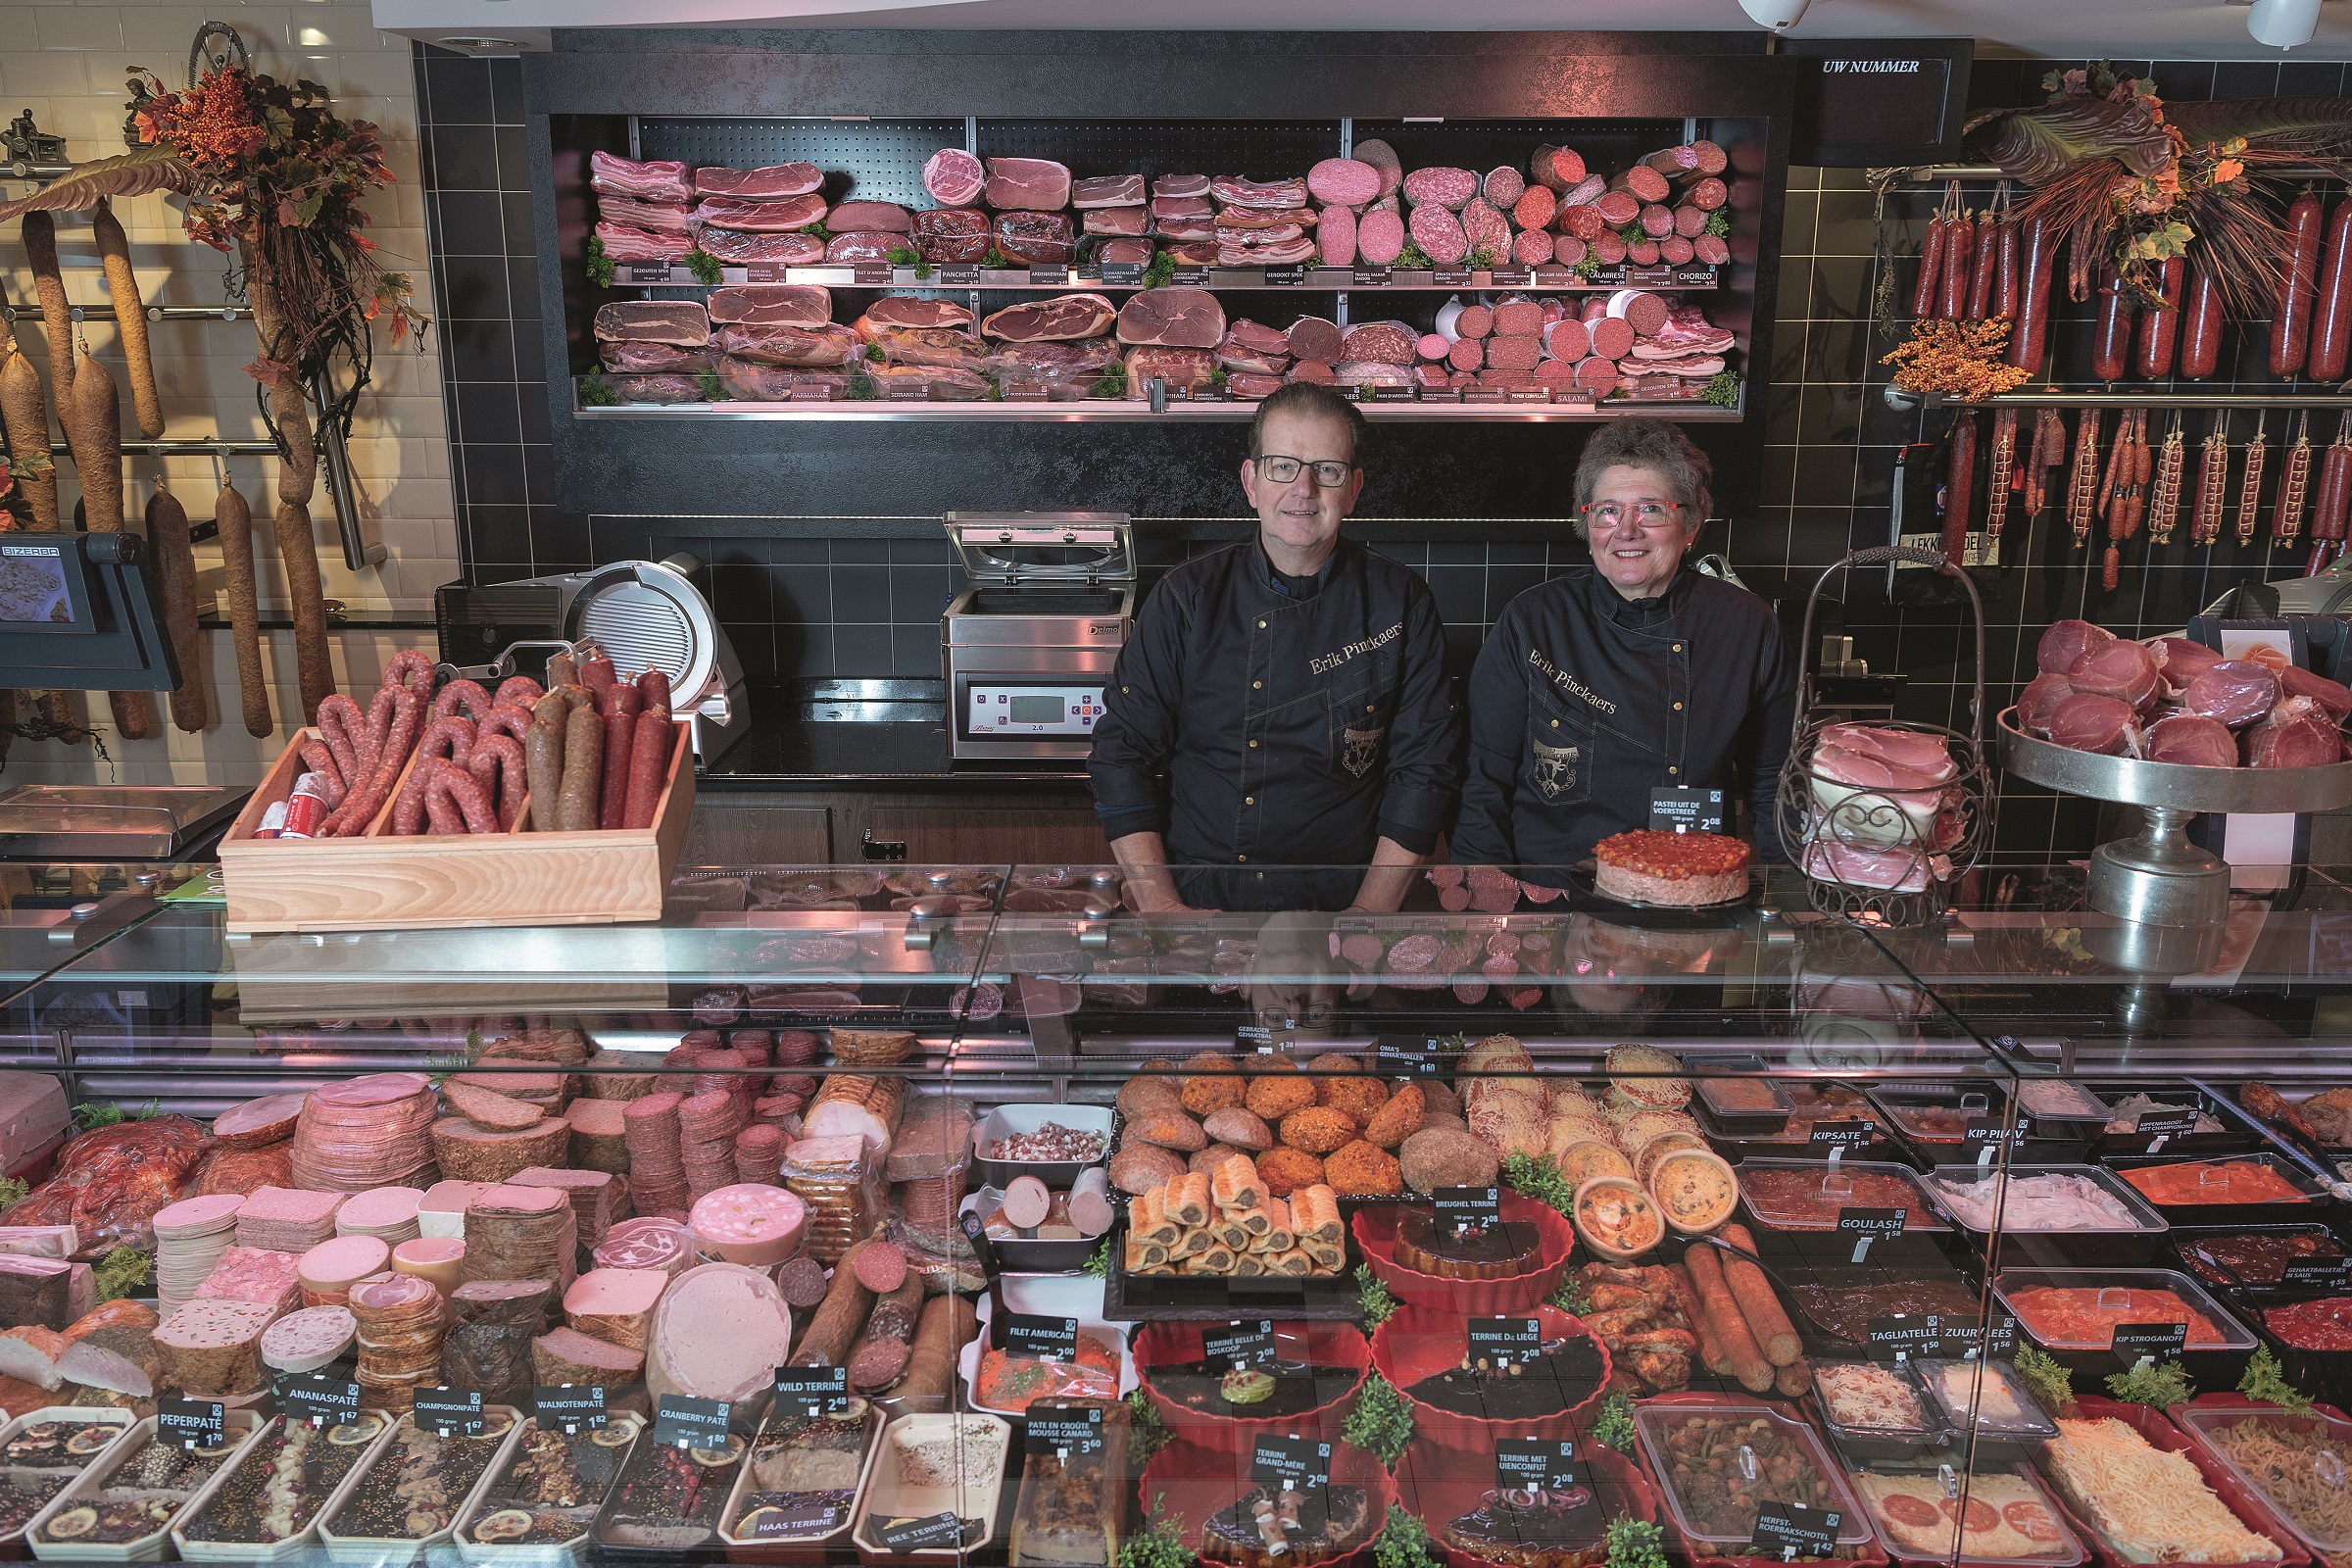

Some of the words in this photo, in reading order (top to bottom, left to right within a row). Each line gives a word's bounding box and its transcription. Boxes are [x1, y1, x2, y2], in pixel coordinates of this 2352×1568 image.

[1823, 61, 1848, 73] UW
[1849, 61, 1919, 73] NUMMER
[1089, 626, 1117, 635] Delmo
[1309, 653, 1344, 674] Erik
[1529, 649, 1555, 678] Erik
[1553, 670, 1616, 714] Pinckaers
[1701, 818, 1720, 829] 208
[1279, 1042, 1294, 1051] 138
[1380, 1052, 1424, 1060] GEHAKTBALLEN
[1968, 1129, 1986, 1138] KIP
[2177, 1129, 2192, 1138] 160
[1481, 1215, 1498, 1228] 208
[1840, 1219, 1902, 1228] GOULASH
[1885, 1231, 1901, 1240] 158
[1031, 1329, 1074, 1340] AMERICAIN
[1870, 1328, 1937, 1341] TAGLIATELLE
[1205, 1339, 1234, 1348] TERRINE
[1235, 1335, 1254, 1344] BELLE
[1922, 1341, 1939, 1353] 150
[1992, 1341, 2010, 1351] 156
[1056, 1348, 1074, 1359] 200
[1207, 1345, 1241, 1355] BOSKOOP
[1256, 1348, 1274, 1362] 208
[1521, 1349, 1540, 1362] 208
[2164, 1348, 2181, 1357] 156
[777, 1383, 803, 1392] WILD
[805, 1382, 845, 1391] TERRINE
[289, 1390, 358, 1406] ANANASPATÉ
[537, 1399, 604, 1408] WALNOTENPATÉ
[828, 1397, 847, 1410] 248
[416, 1402, 480, 1411] CHAMPIGNONPATÉ
[161, 1413, 221, 1429] PEPERPATÉ
[339, 1411, 357, 1423] 167
[589, 1415, 606, 1428] 182
[661, 1410, 706, 1423] CRANBERRY
[708, 1416, 727, 1426] PATÉ
[465, 1421, 482, 1433] 167
[206, 1434, 222, 1446] 170
[708, 1434, 725, 1446] 180
[1081, 1439, 1102, 1453] 360
[1256, 1448, 1287, 1459] TERRINE
[1255, 1457, 1306, 1470] GRAND-MÈRE
[1307, 1474, 1328, 1488] 208
[1552, 1474, 1573, 1488] 208
[791, 1518, 832, 1529] TERRINE
[1760, 1516, 1791, 1527] HERFST-
[887, 1533, 908, 1544] REE
[911, 1520, 957, 1538] TERRINE
[1758, 1523, 1829, 1541] ROERBAKSCHOTEL
[1813, 1543, 1833, 1554] 142
